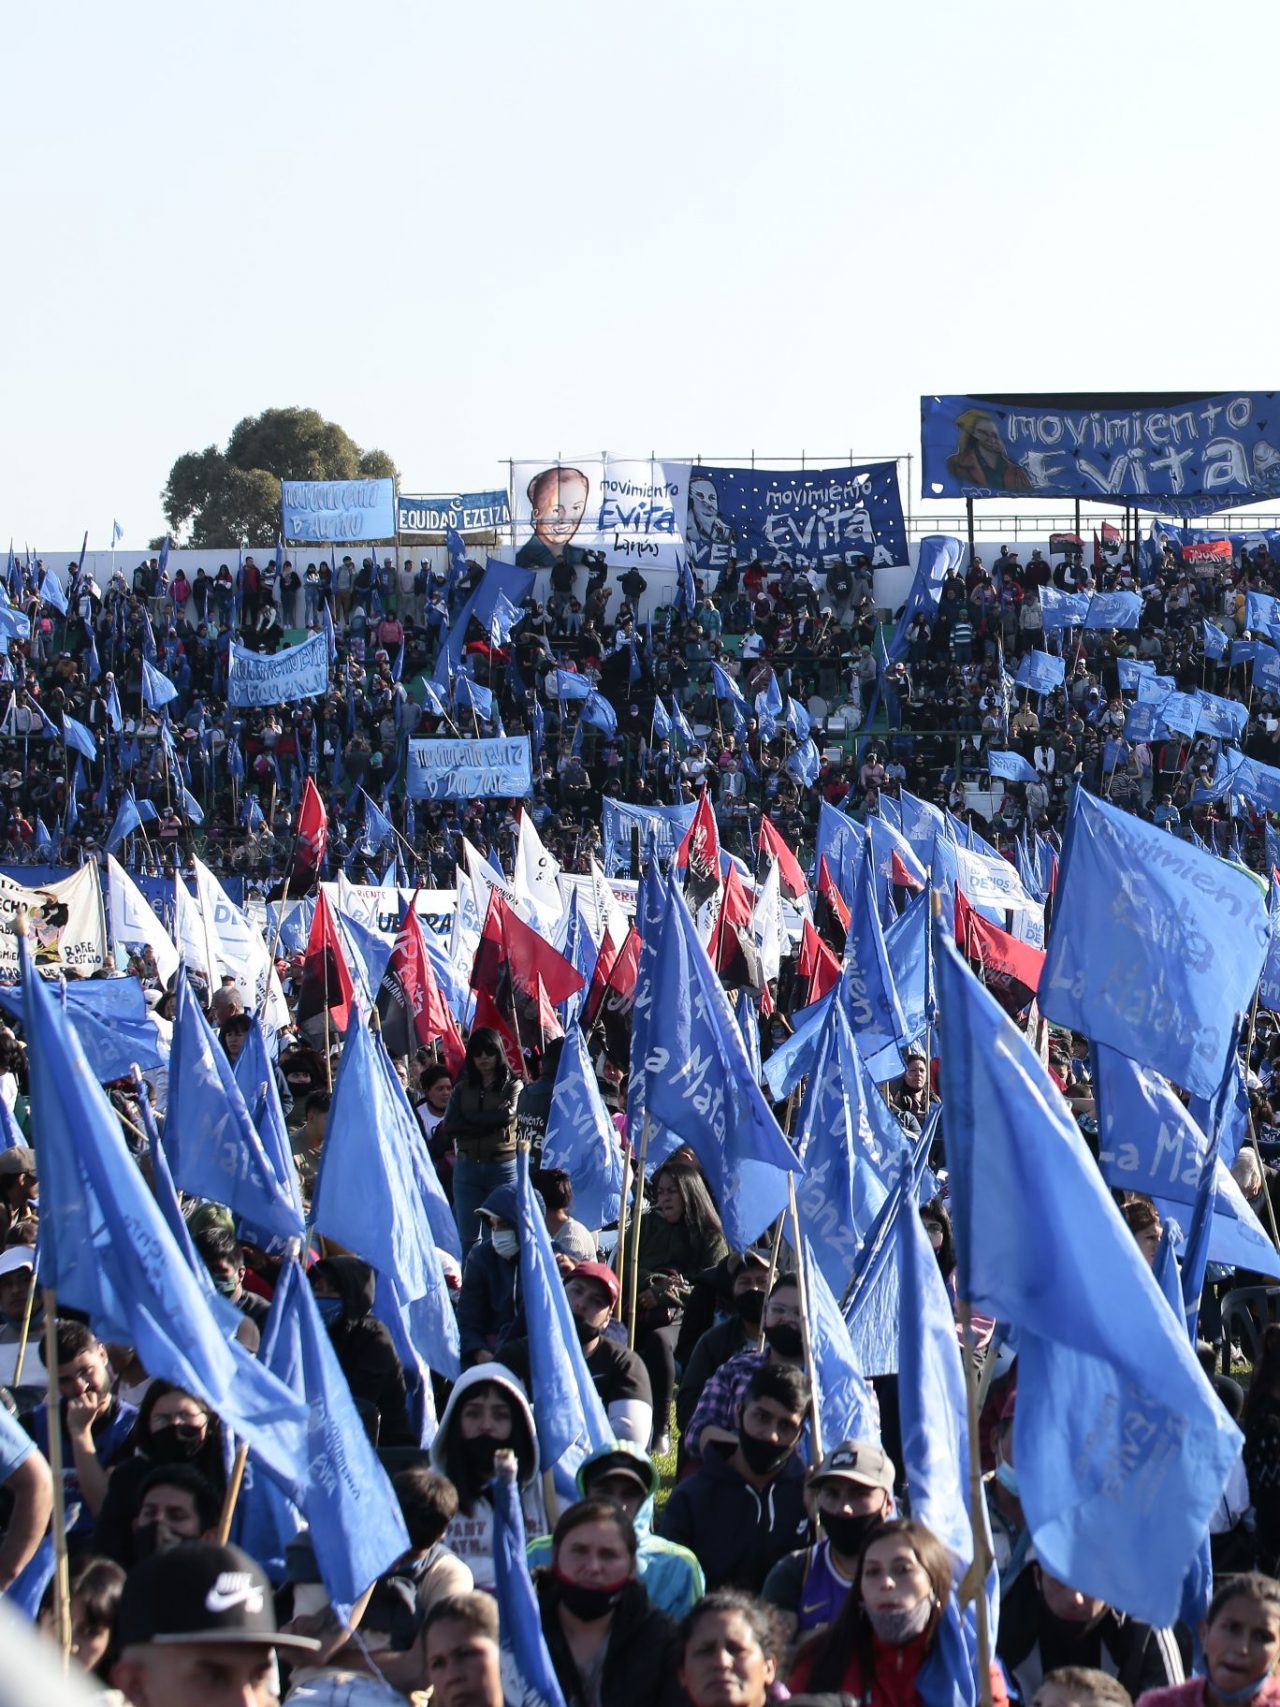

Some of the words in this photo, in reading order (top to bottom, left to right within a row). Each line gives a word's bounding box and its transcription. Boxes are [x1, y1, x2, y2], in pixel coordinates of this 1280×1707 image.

[599, 479, 680, 498] movimiento
[765, 479, 873, 507] movimiento
[401, 509, 457, 530] EQUIDAD
[463, 504, 511, 529] EZEIZA
